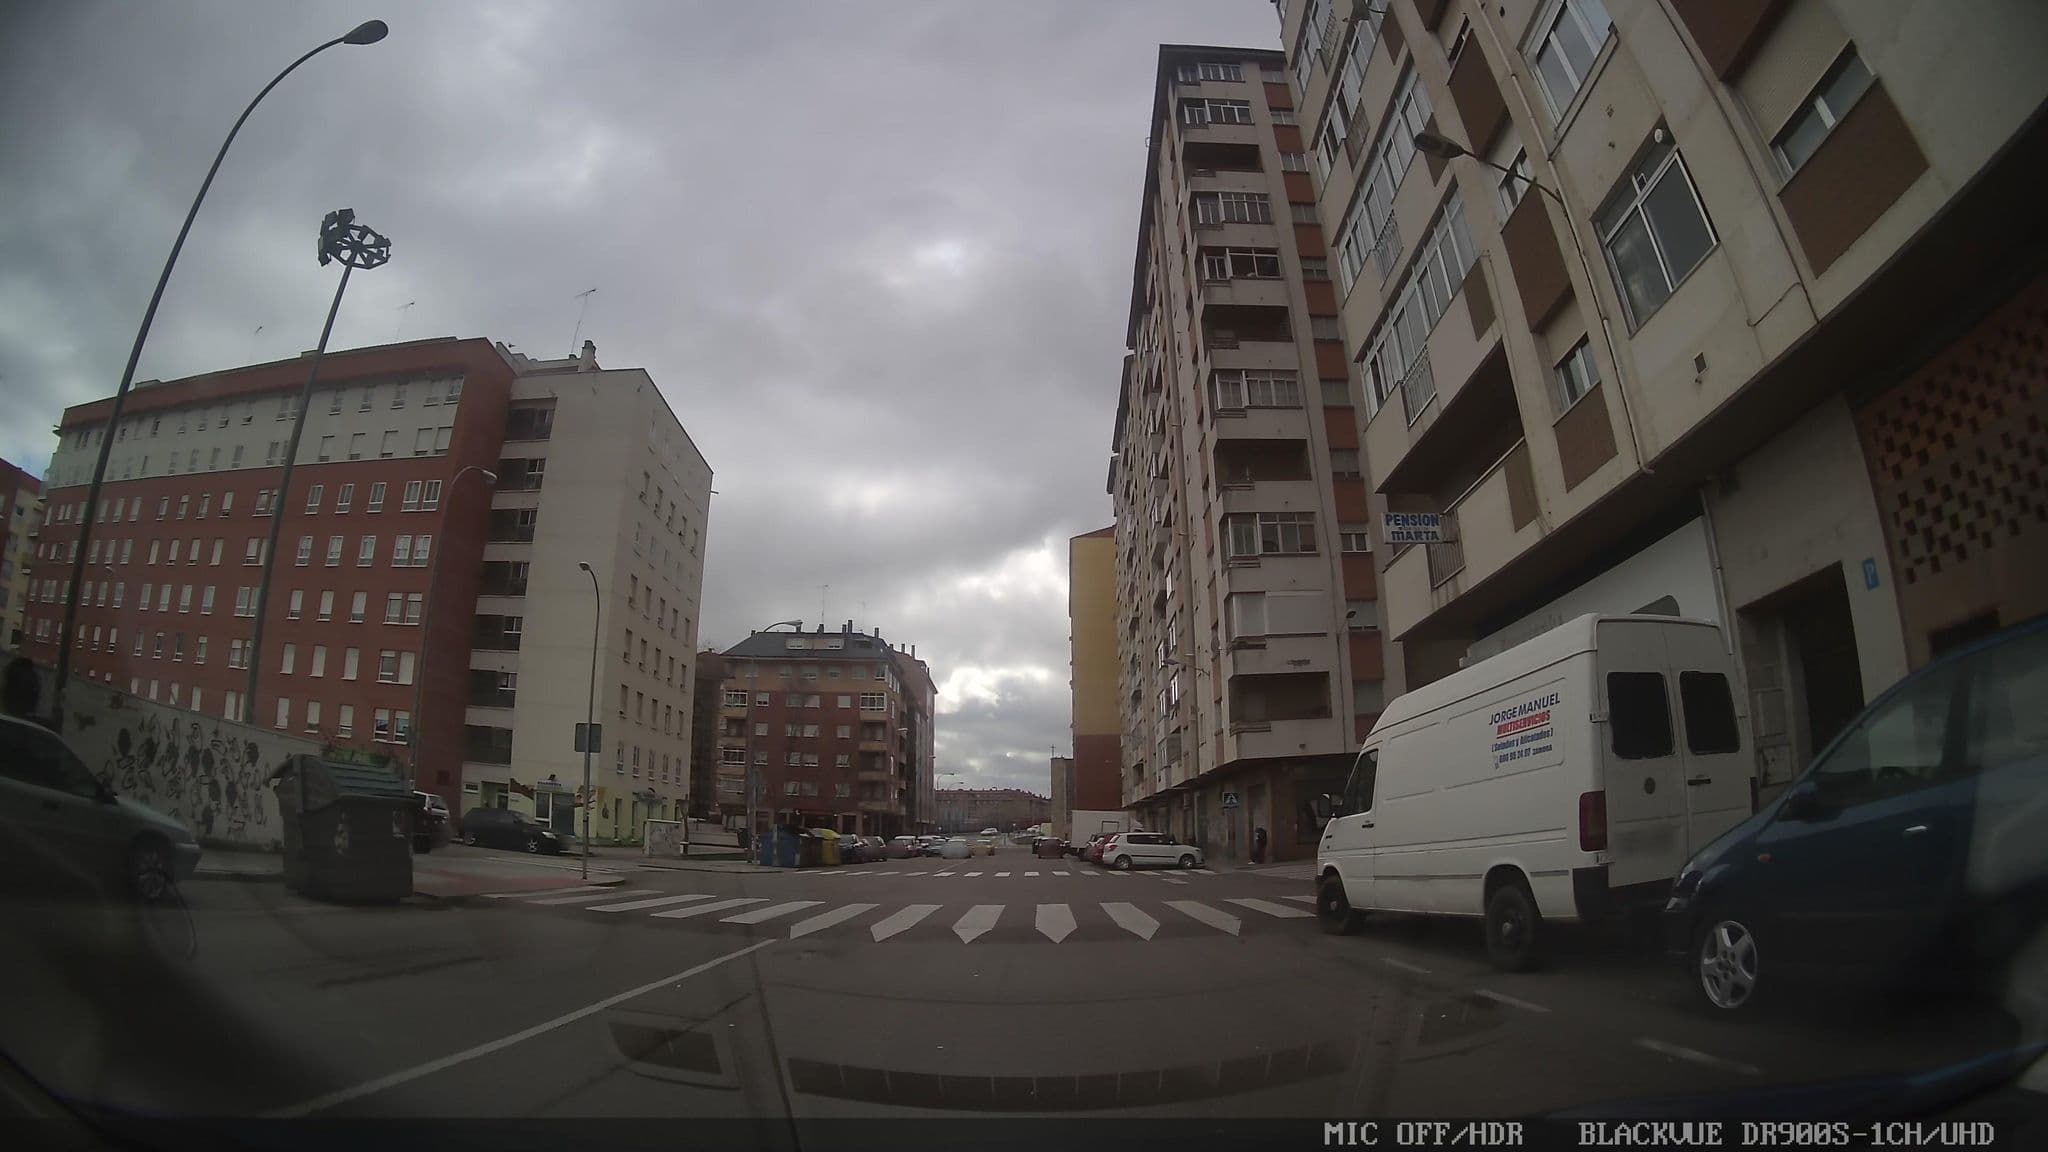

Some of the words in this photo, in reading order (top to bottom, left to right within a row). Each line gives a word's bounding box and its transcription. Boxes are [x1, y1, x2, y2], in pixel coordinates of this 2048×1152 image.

[1385, 513, 1440, 527] PENSION
[1391, 530, 1440, 541] MARTA
[1863, 562, 1875, 585] P
[1489, 706, 1518, 726] JORGE
[1518, 692, 1560, 716] MANUEL
[1497, 709, 1551, 736] MULTISERVICIOS
